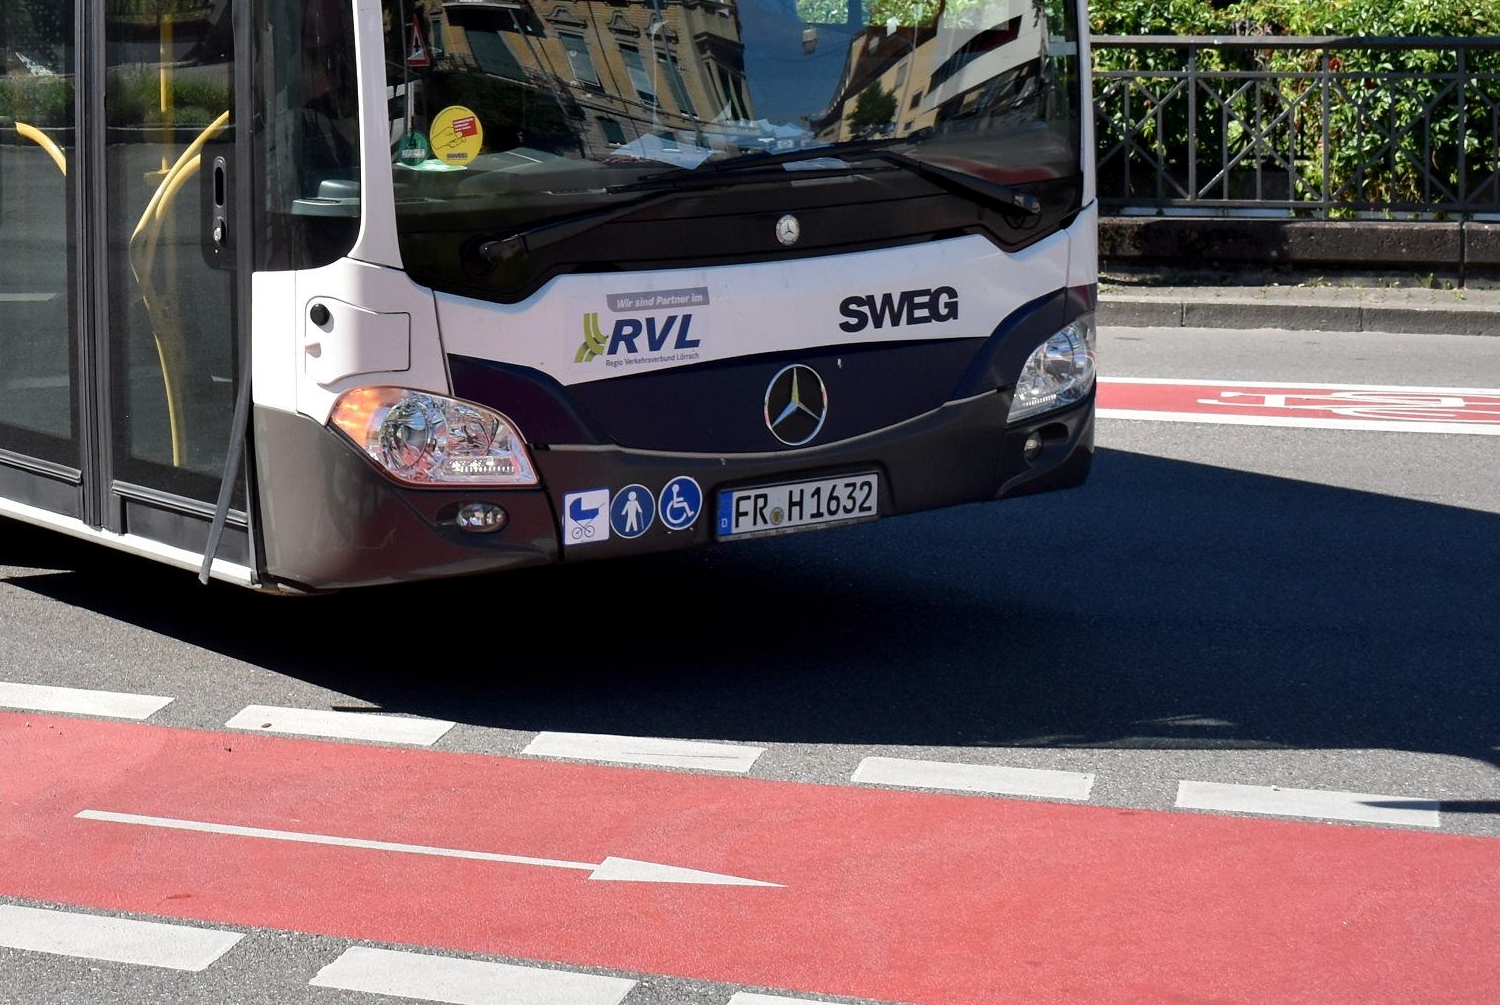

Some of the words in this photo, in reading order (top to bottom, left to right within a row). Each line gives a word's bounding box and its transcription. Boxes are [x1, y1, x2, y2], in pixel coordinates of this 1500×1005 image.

[616, 298, 633, 309] Wir
[634, 296, 654, 307] sind
[655, 294, 690, 307] Partner
[690, 292, 703, 303] im
[838, 285, 959, 333] SWEG
[606, 313, 701, 356] RVL
[605, 358, 623, 368] Regio
[624, 355, 676, 366] Verkehrsverbund
[676, 351, 700, 361] Lörrach
[734, 493, 768, 529] FR
